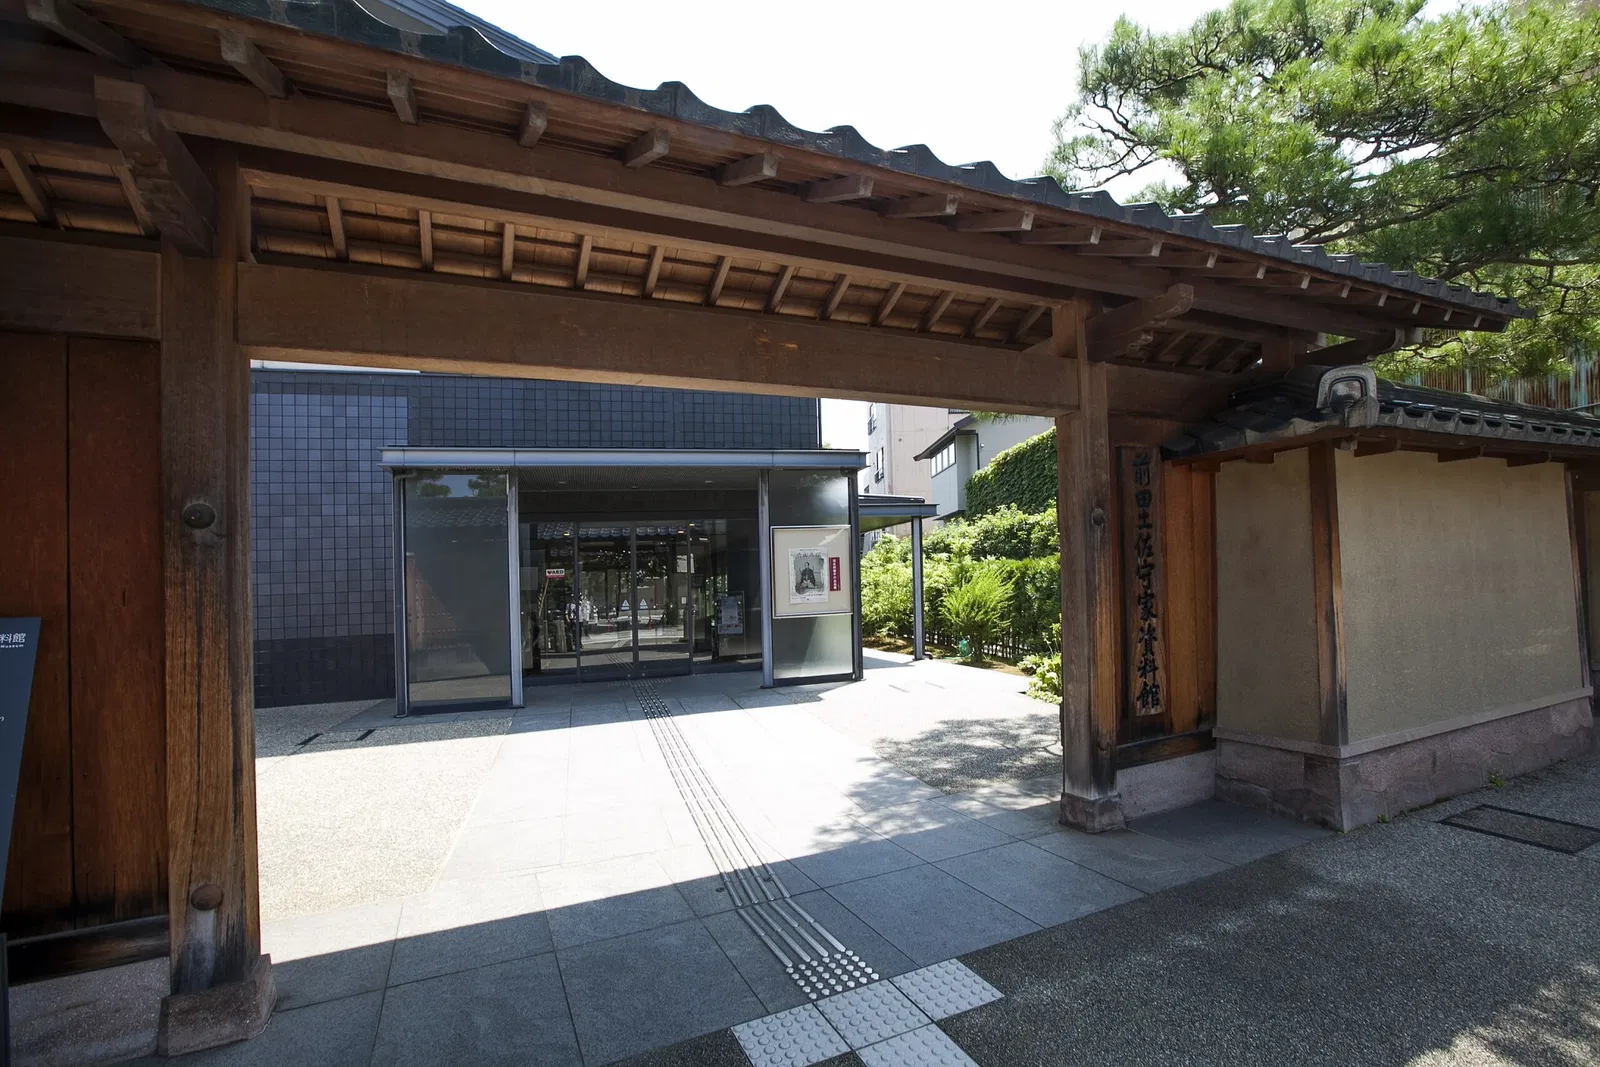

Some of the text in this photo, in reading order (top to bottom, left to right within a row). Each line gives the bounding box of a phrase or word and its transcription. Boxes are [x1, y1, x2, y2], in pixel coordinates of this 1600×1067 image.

[1131, 453, 1161, 708] 前田土佐守家資料館
